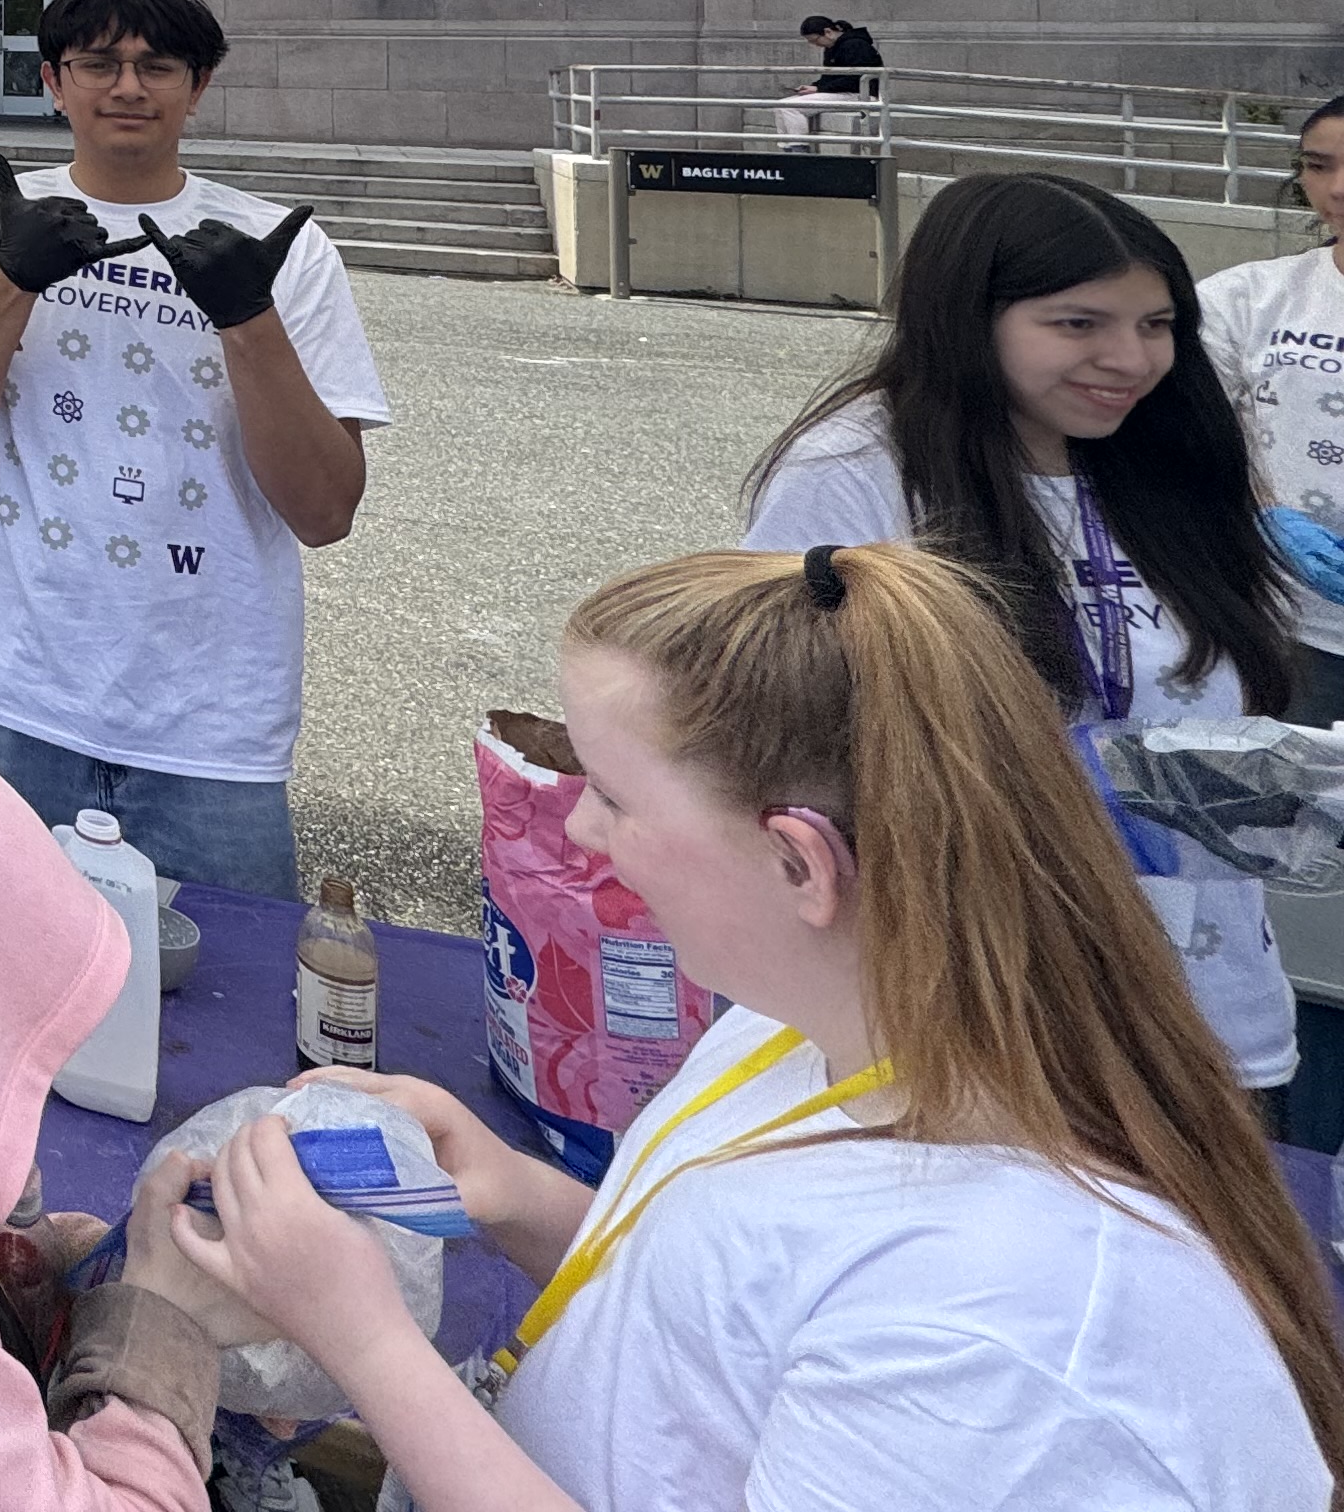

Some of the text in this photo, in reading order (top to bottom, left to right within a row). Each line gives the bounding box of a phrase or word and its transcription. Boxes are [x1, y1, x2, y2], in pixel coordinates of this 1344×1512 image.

[638, 164, 785, 181] W BAGLEY HALL
[41, 284, 220, 336] COVERY DAY
[166, 543, 206, 575] W
[601, 938, 673, 952] Nutrition Facts
[603, 965, 641, 977] Calories
[322, 1021, 372, 1039] KIRKLAND
